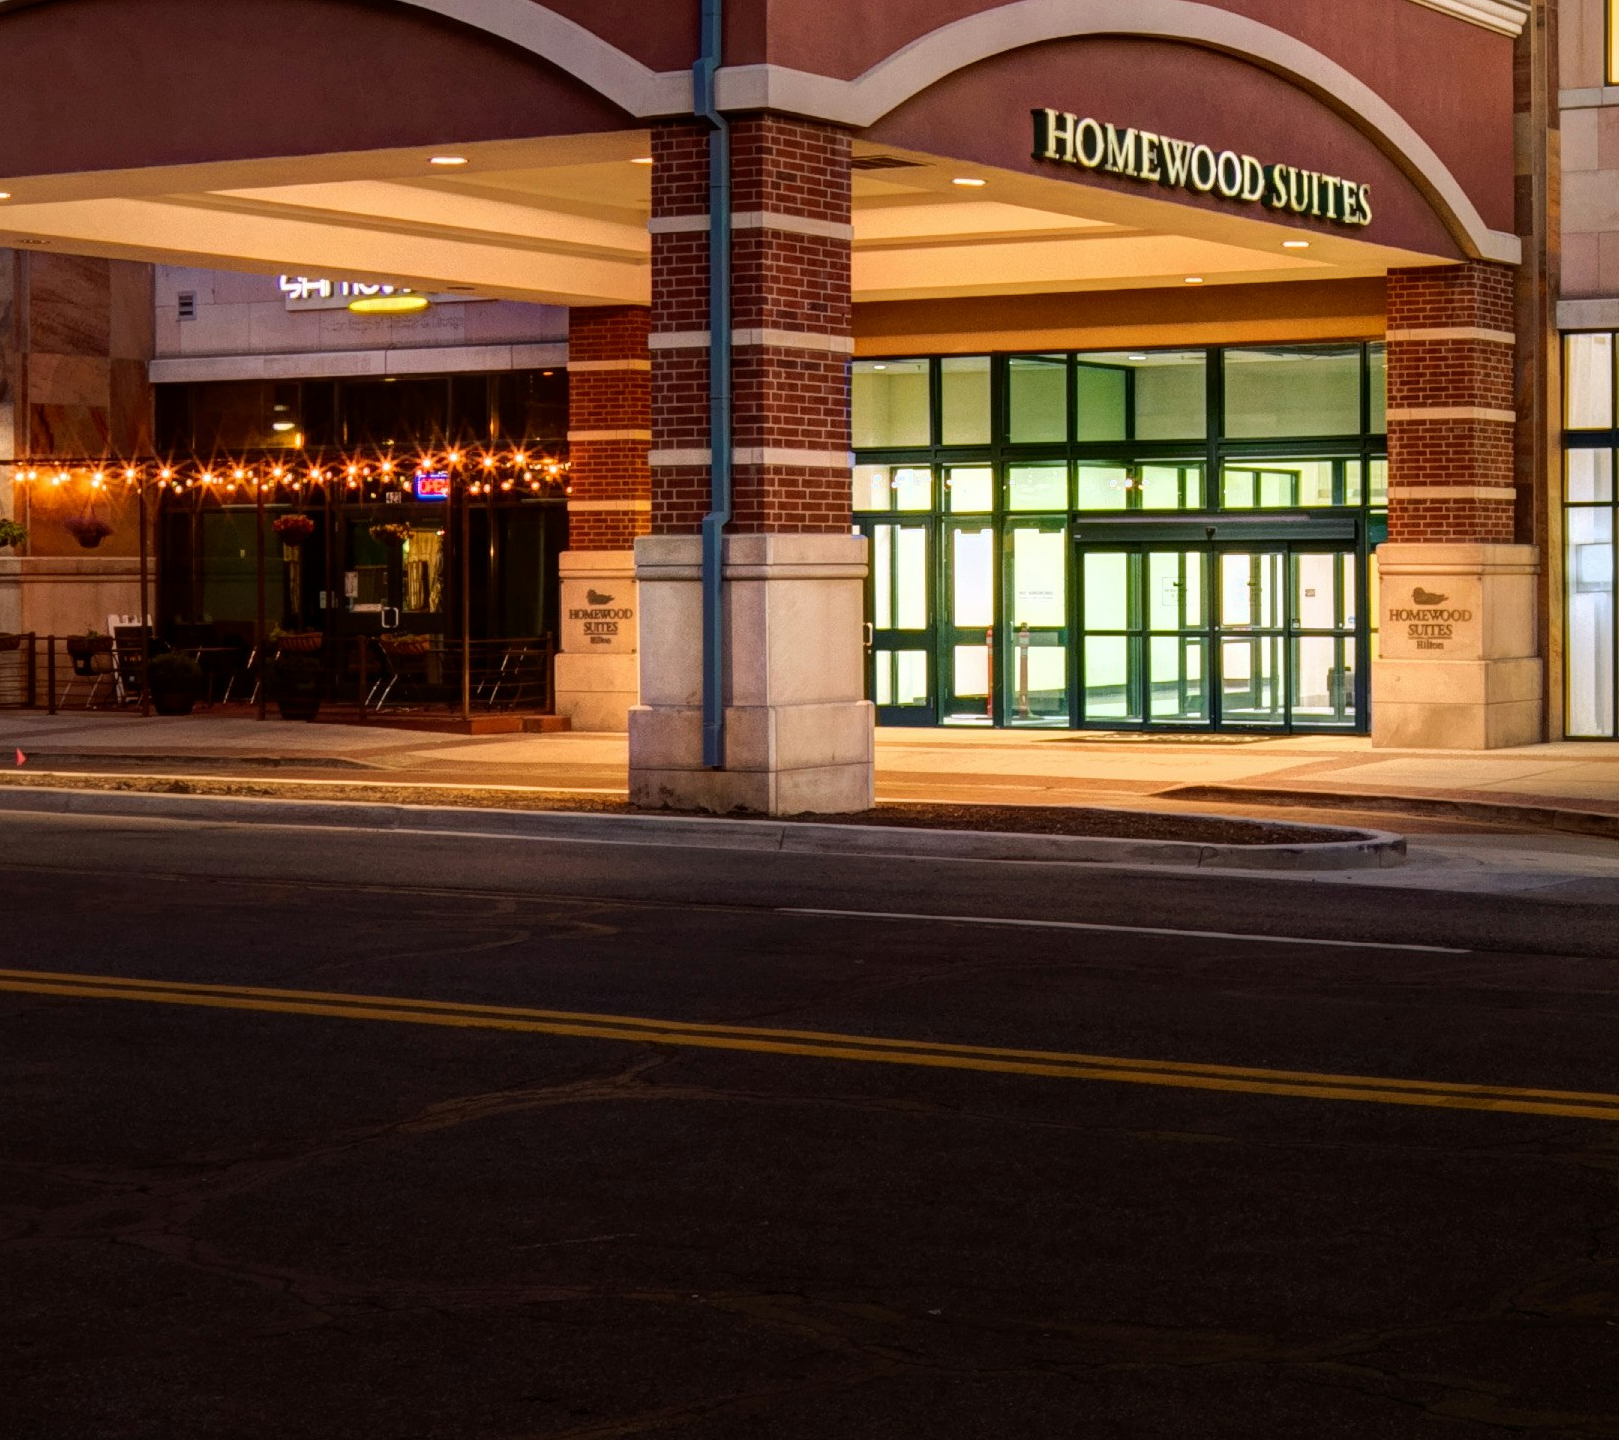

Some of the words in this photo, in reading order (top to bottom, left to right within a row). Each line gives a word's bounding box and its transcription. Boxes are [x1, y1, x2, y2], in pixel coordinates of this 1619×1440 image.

[1039, 107, 1266, 203] HOMEWOOD
[1271, 163, 1373, 226] SUITES
[568, 608, 633, 620] HOMEWOOD
[1389, 609, 1473, 622] HOMEWOOD
[583, 621, 618, 633] SUITES
[1407, 624, 1453, 636] SUITES
[1416, 639, 1445, 650] Hilton
